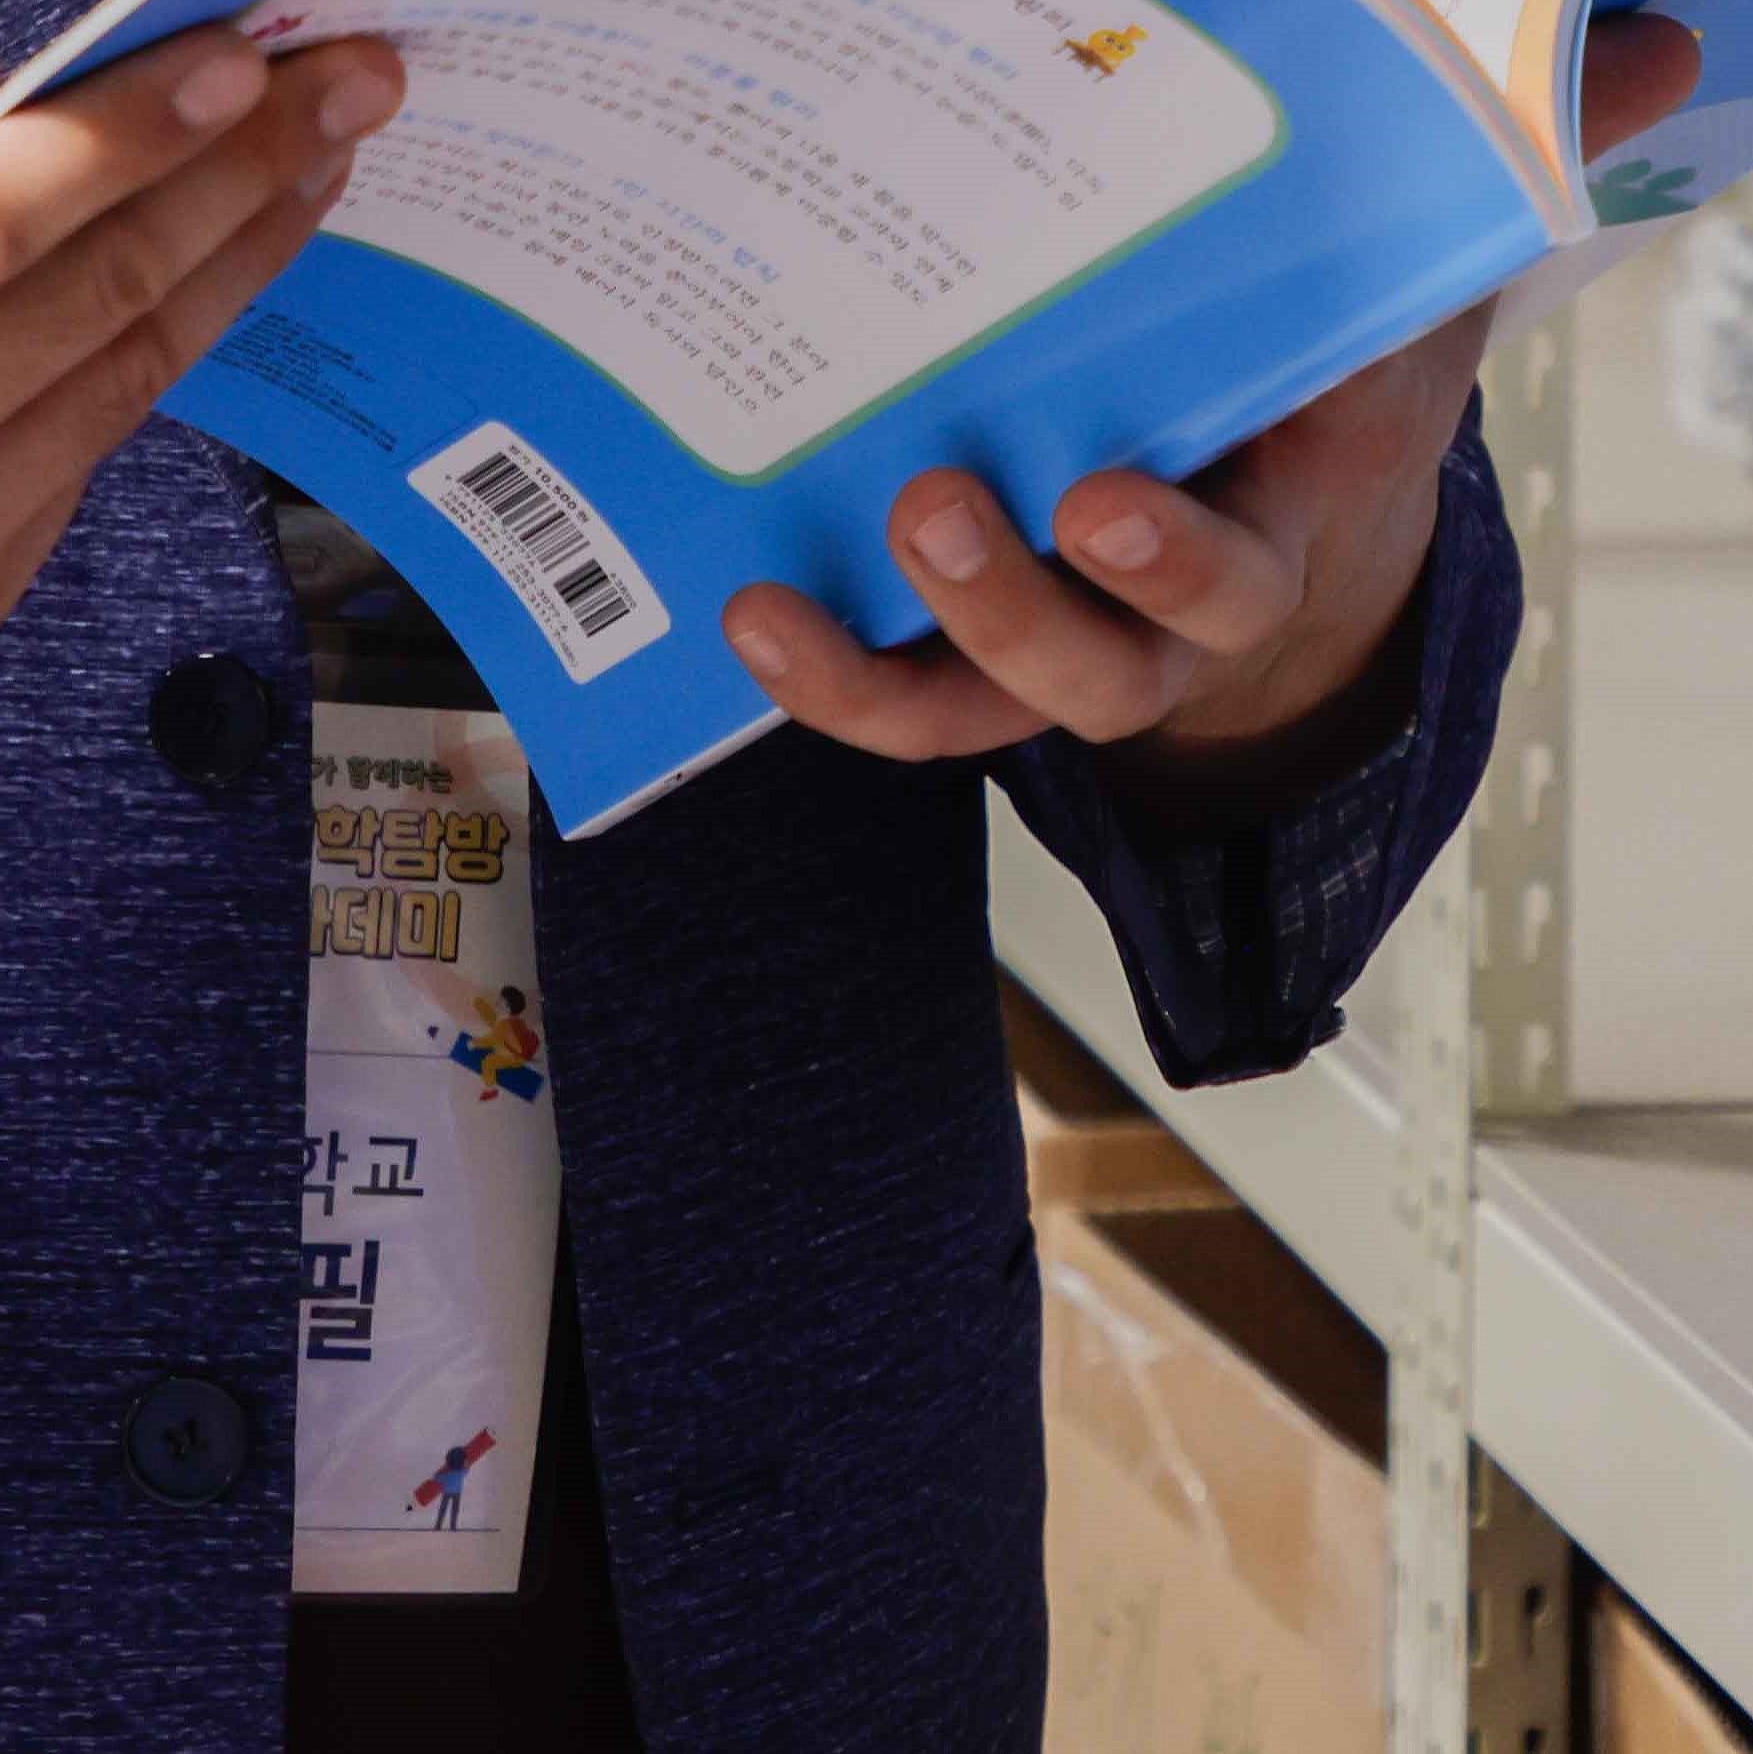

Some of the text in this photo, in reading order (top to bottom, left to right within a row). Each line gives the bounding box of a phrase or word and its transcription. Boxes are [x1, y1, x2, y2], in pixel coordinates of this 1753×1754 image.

[347, 756, 453, 794] 함께하는
[315, 804, 511, 884] 학탐방
[300, 1240, 380, 1361] 필
